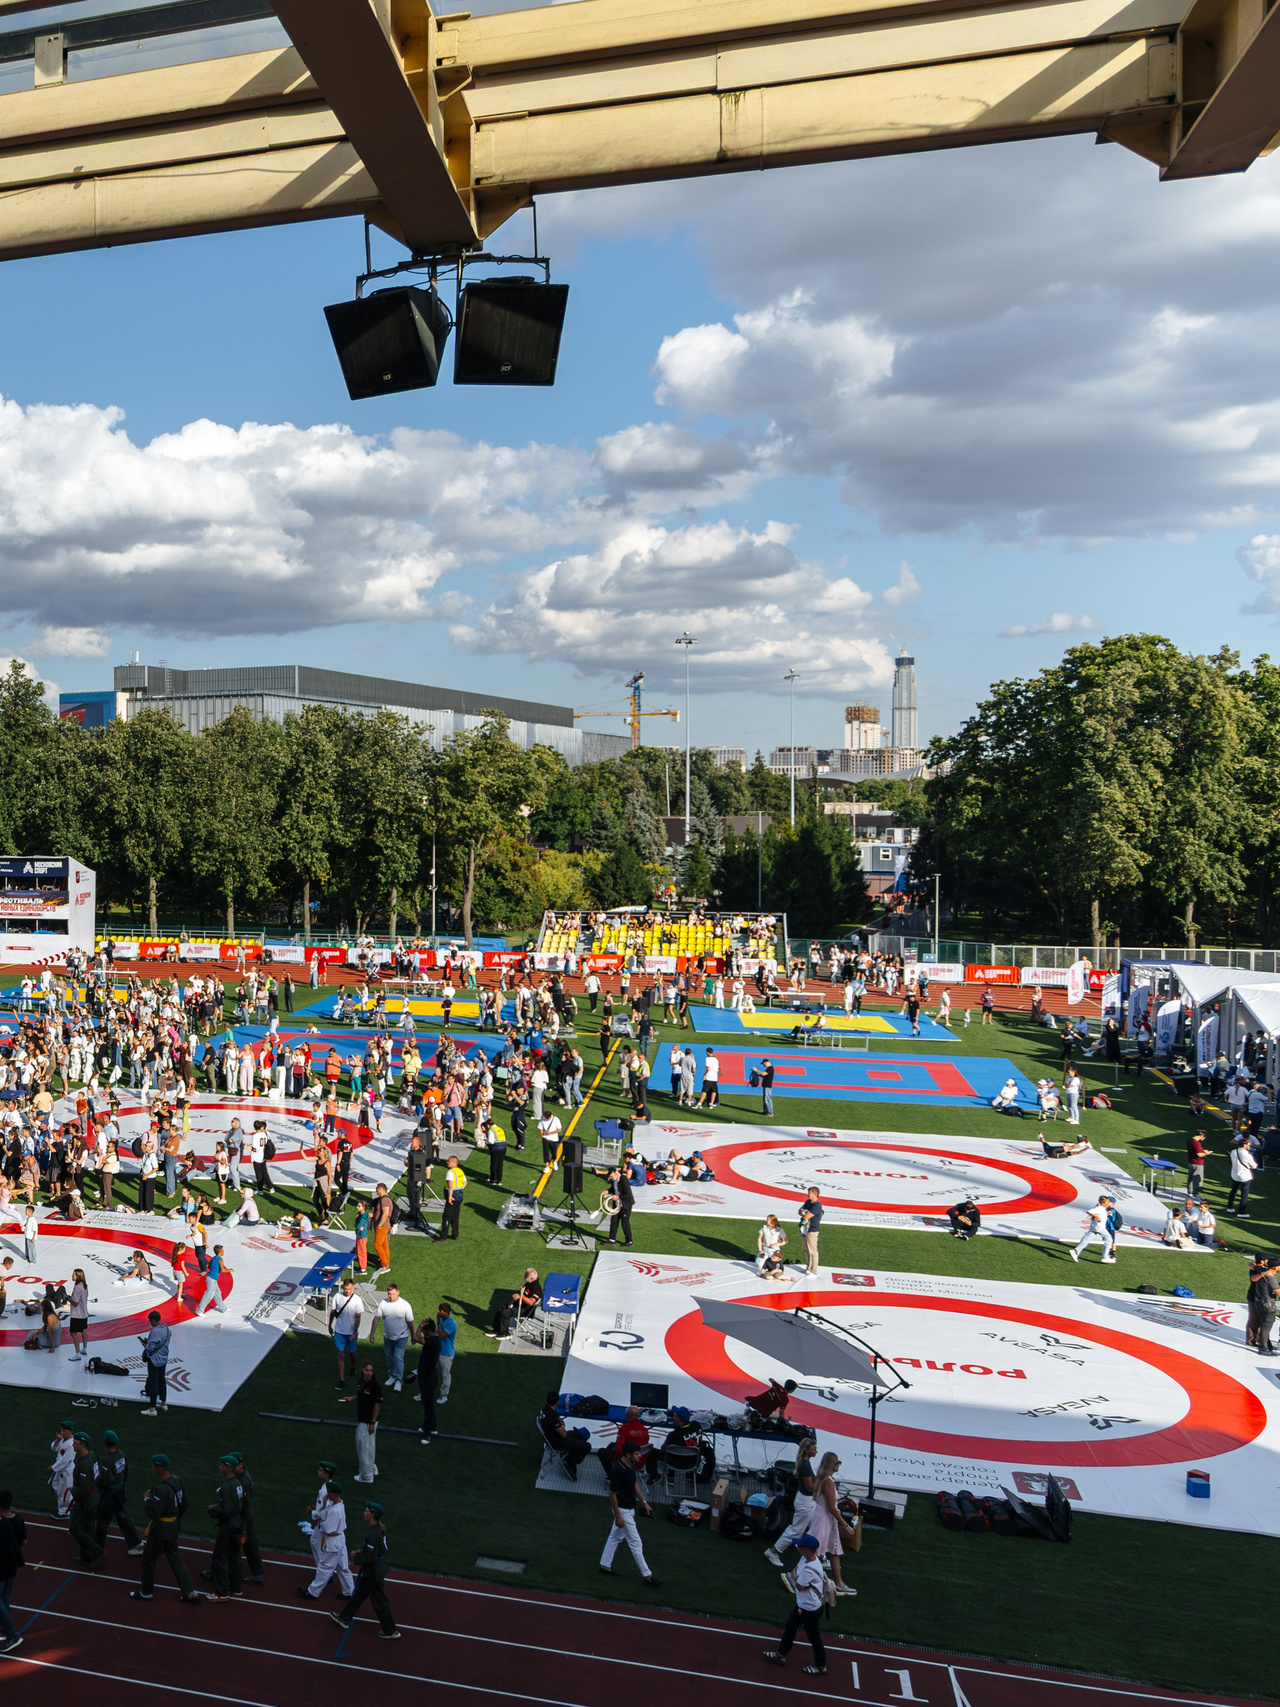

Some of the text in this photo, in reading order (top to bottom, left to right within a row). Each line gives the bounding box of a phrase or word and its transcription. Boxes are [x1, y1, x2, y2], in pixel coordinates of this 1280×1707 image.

[814, 1168, 929, 1181] РОЛЬФ
[979, 1332, 1085, 1366] AVEASA
[1017, 1395, 1110, 1418] AVEASA
[854, 1452, 997, 1474] города Москы
[876, 1469, 1002, 1490] Департамент
[934, 1468, 999, 1481] спорта
[884, 1669, 929, 1703] 1
